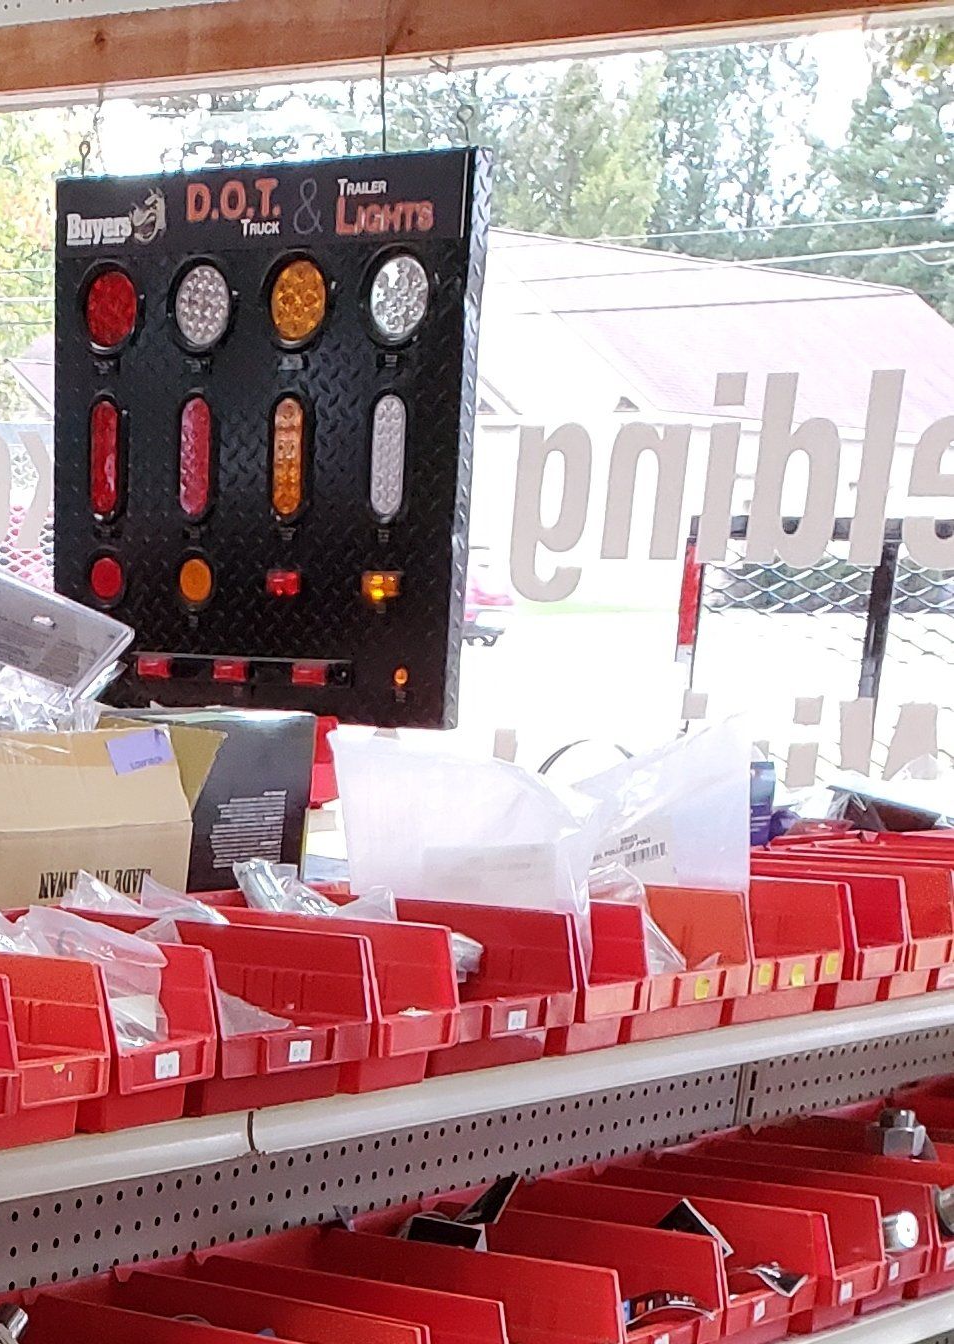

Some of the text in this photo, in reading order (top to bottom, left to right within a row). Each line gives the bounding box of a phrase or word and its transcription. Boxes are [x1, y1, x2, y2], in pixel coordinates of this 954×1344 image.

[186, 178, 281, 222] D.O.T.
[294, 178, 323, 235] &
[66, 213, 131, 246] Buyers
